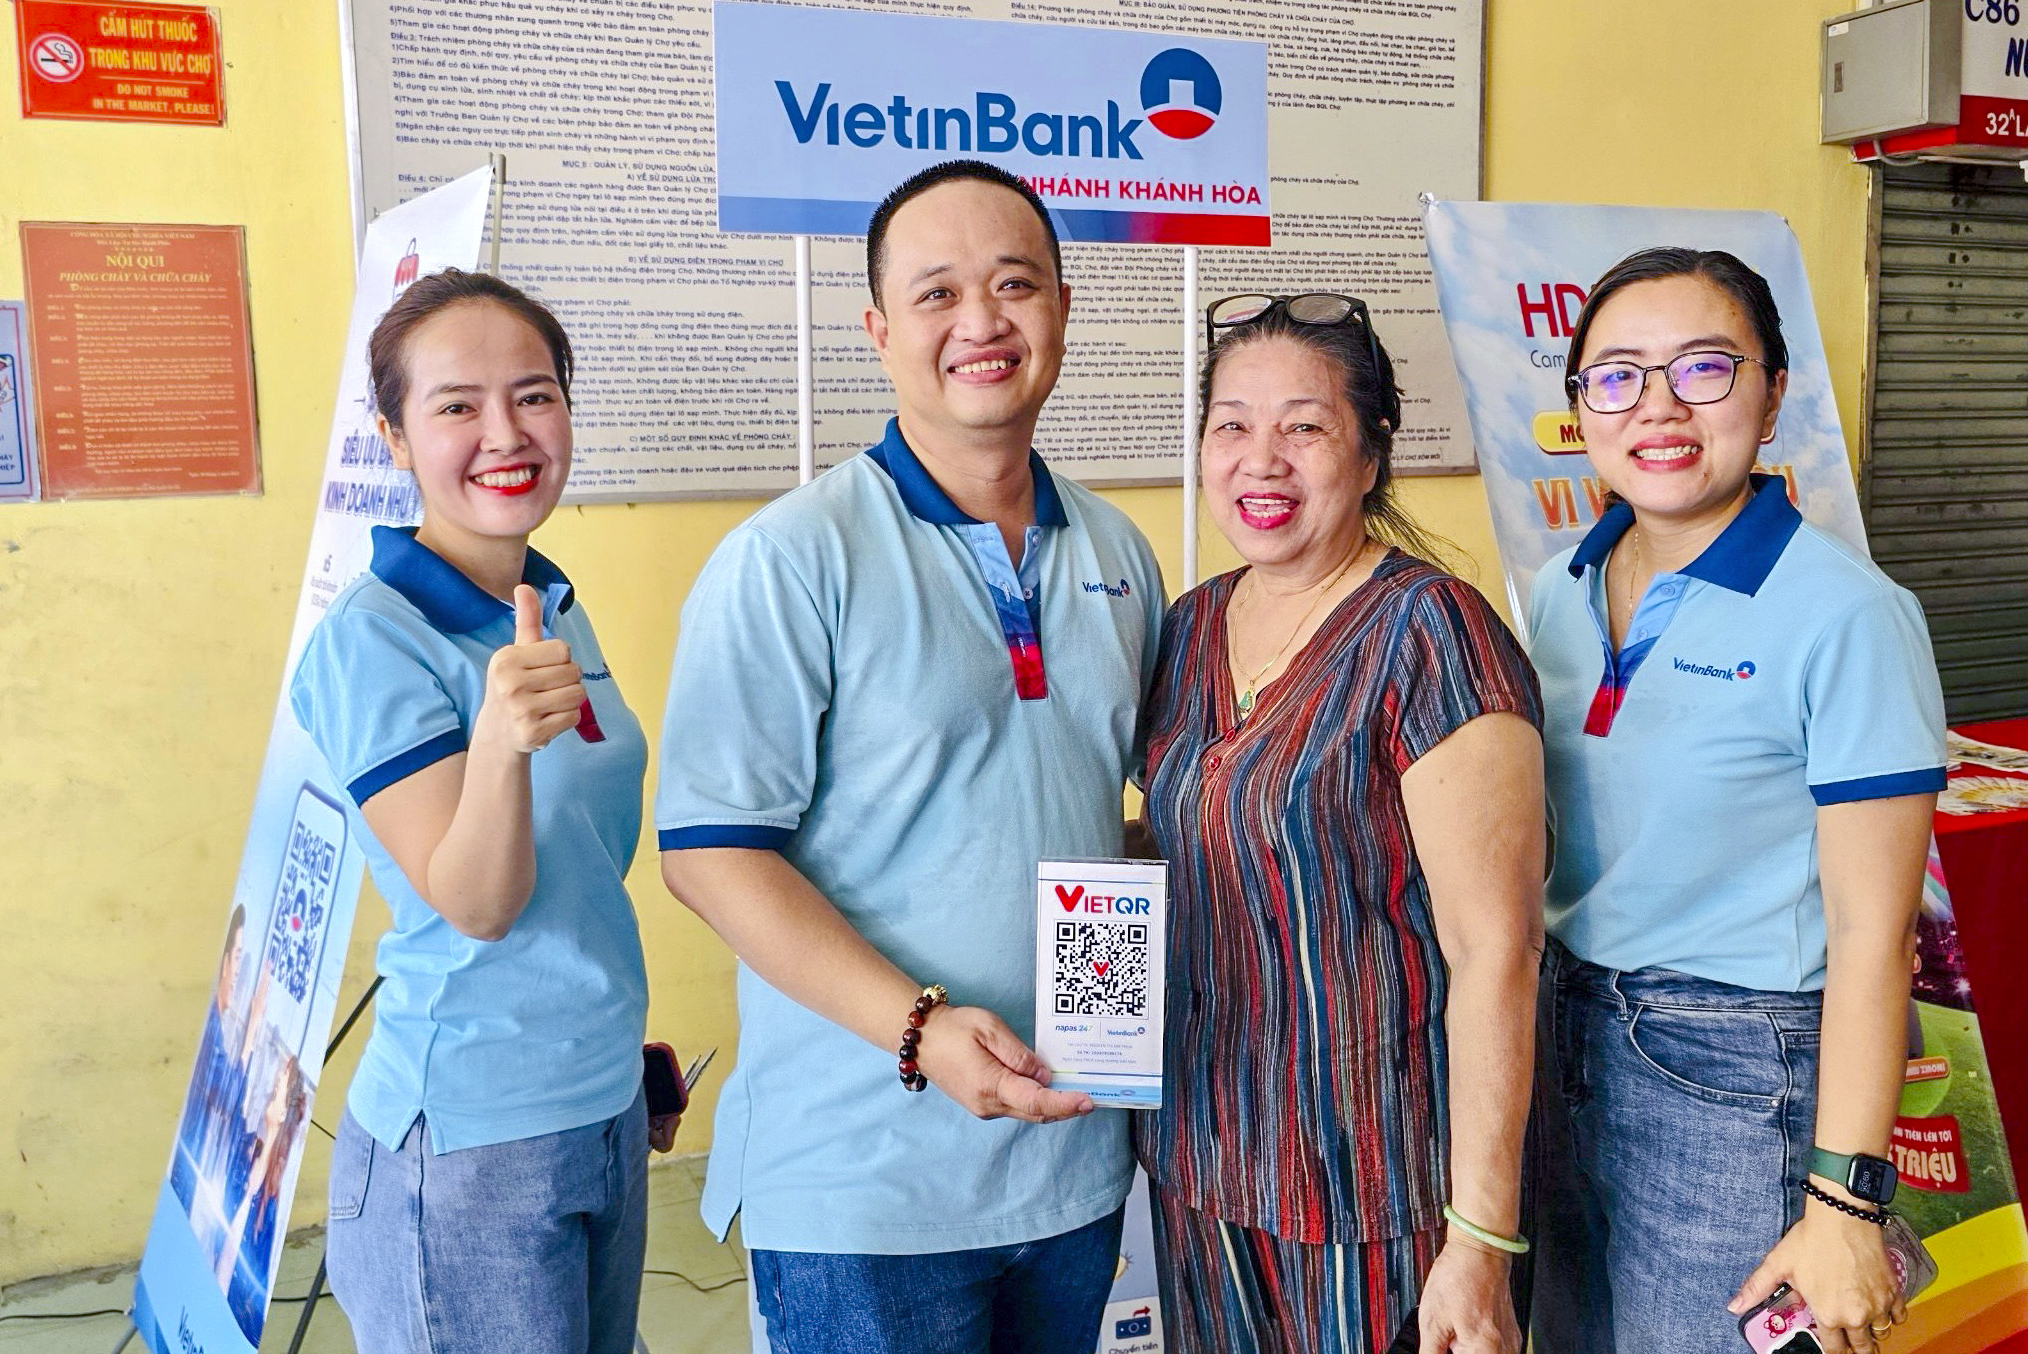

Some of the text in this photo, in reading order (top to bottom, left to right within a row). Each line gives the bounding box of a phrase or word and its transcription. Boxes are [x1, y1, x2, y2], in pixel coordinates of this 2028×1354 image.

[1965, 0, 2020, 26] C86
[100, 10, 198, 42] CẤM HÚT THUỐC
[133, 50, 157, 71] KHU
[160, 50, 184, 76] VỰC
[187, 53, 214, 78] CHỢ
[117, 83, 189, 98] DO NOT SMOKE
[92, 98, 104, 109] IN
[105, 99, 125, 111] THE
[774, 80, 1144, 160] VietinBank
[1119, 177, 1204, 203] KHÁNH
[1212, 180, 1262, 205] HÒA
[105, 252, 165, 270] NỘI QUI
[59, 270, 212, 283] PHÒNG CHÁY VÀ CHỮA CHÁY
[1673, 657, 1735, 681] VietinBank
[1055, 884, 1150, 915] VIETQR
[1055, 1025, 1077, 1033] napas
[1107, 1029, 1138, 1037] VietinBank
[1923, 1129, 1938, 1143] LÊN
[1894, 1144, 1957, 1188] TRIỆU
